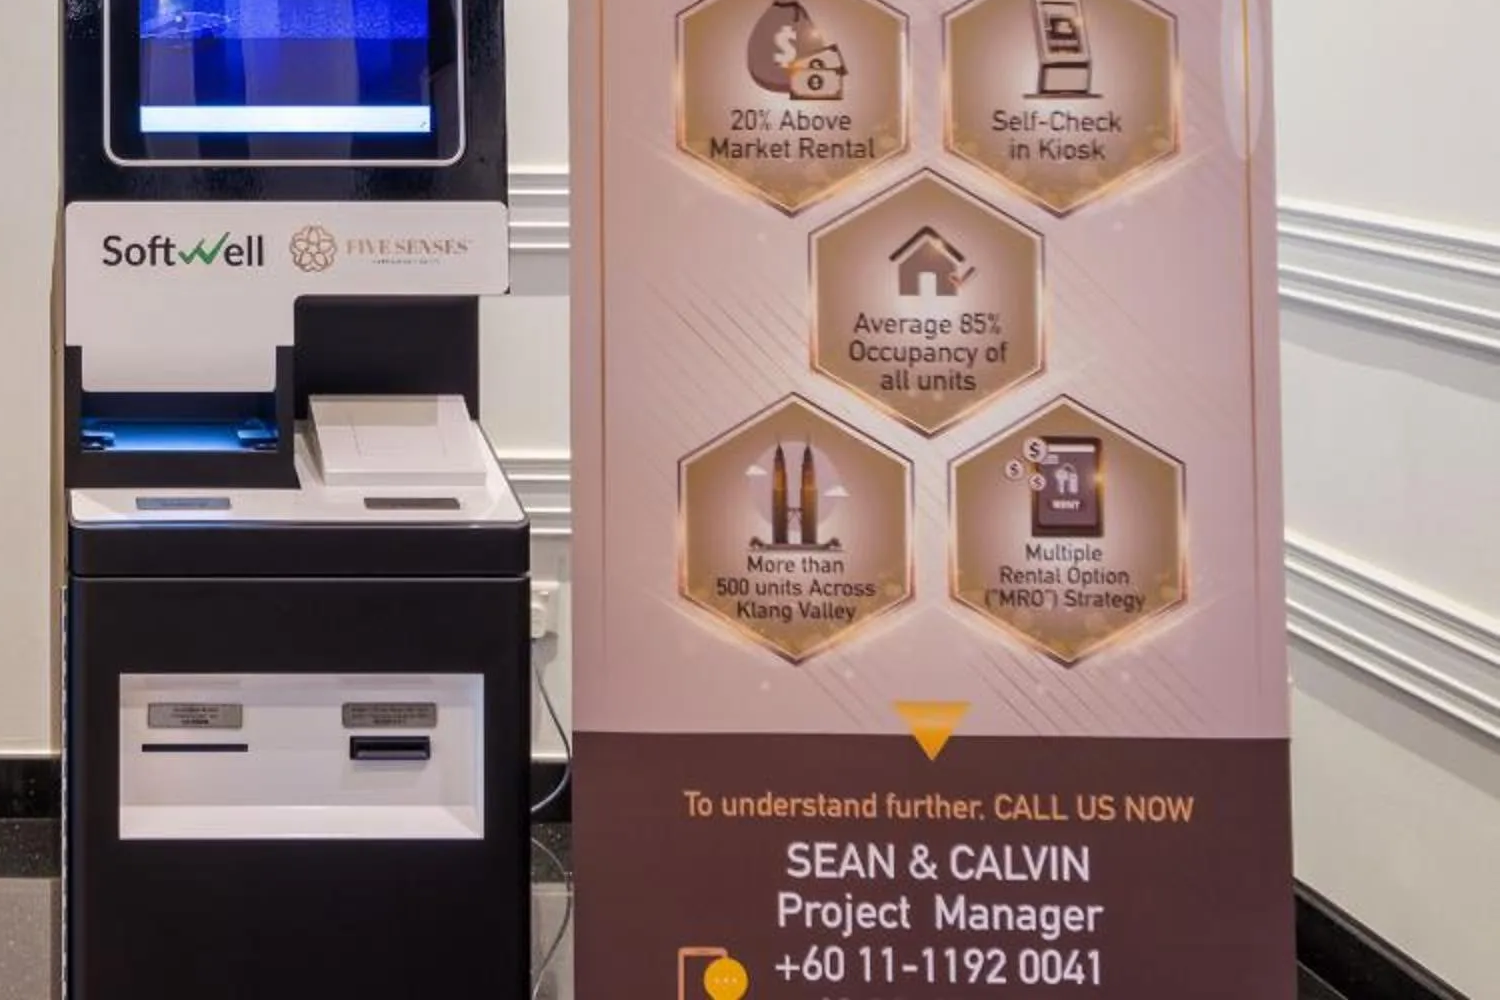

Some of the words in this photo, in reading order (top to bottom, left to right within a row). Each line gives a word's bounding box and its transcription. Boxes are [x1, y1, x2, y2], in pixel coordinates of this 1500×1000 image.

[730, 110, 772, 131] 20%
[779, 110, 852, 132] Above
[992, 110, 1122, 133] Self-Check
[710, 138, 790, 160] Market
[799, 138, 875, 161] Rental
[1010, 138, 1033, 160] in
[1038, 138, 1107, 161] Kiosk
[346, 238, 392, 256] FIVE
[394, 238, 468, 256] SENSES
[853, 313, 952, 339] Average
[959, 313, 1003, 335] 85%
[848, 341, 977, 367] Occupancy
[984, 341, 1008, 363] of
[880, 370, 910, 391] all
[917, 371, 977, 392] units
[747, 555, 794, 575] More
[801, 556, 844, 575] than
[1025, 543, 1103, 566] Multiple
[716, 578, 749, 597] 500
[755, 578, 802, 597] units
[809, 578, 876, 598] Across
[1000, 566, 1061, 586] Rental
[1067, 567, 1130, 589] Option
[1064, 589, 1147, 612] Strategy
[736, 601, 792, 624] Klang
[800, 603, 856, 624] Valley
[683, 791, 713, 817] To
[721, 792, 877, 818] understand
[994, 794, 1068, 822] CALL
[1076, 795, 1116, 822] US
[1125, 796, 1194, 823] NOW
[786, 843, 897, 879] SEAN
[909, 845, 937, 879] &
[949, 846, 1090, 881] CALVIN
[777, 892, 911, 937] Project
[934, 896, 1104, 940] Manager
[774, 945, 845, 983] +60
[859, 948, 1006, 984] 11-1192
[1018, 949, 1101, 985] 0041
